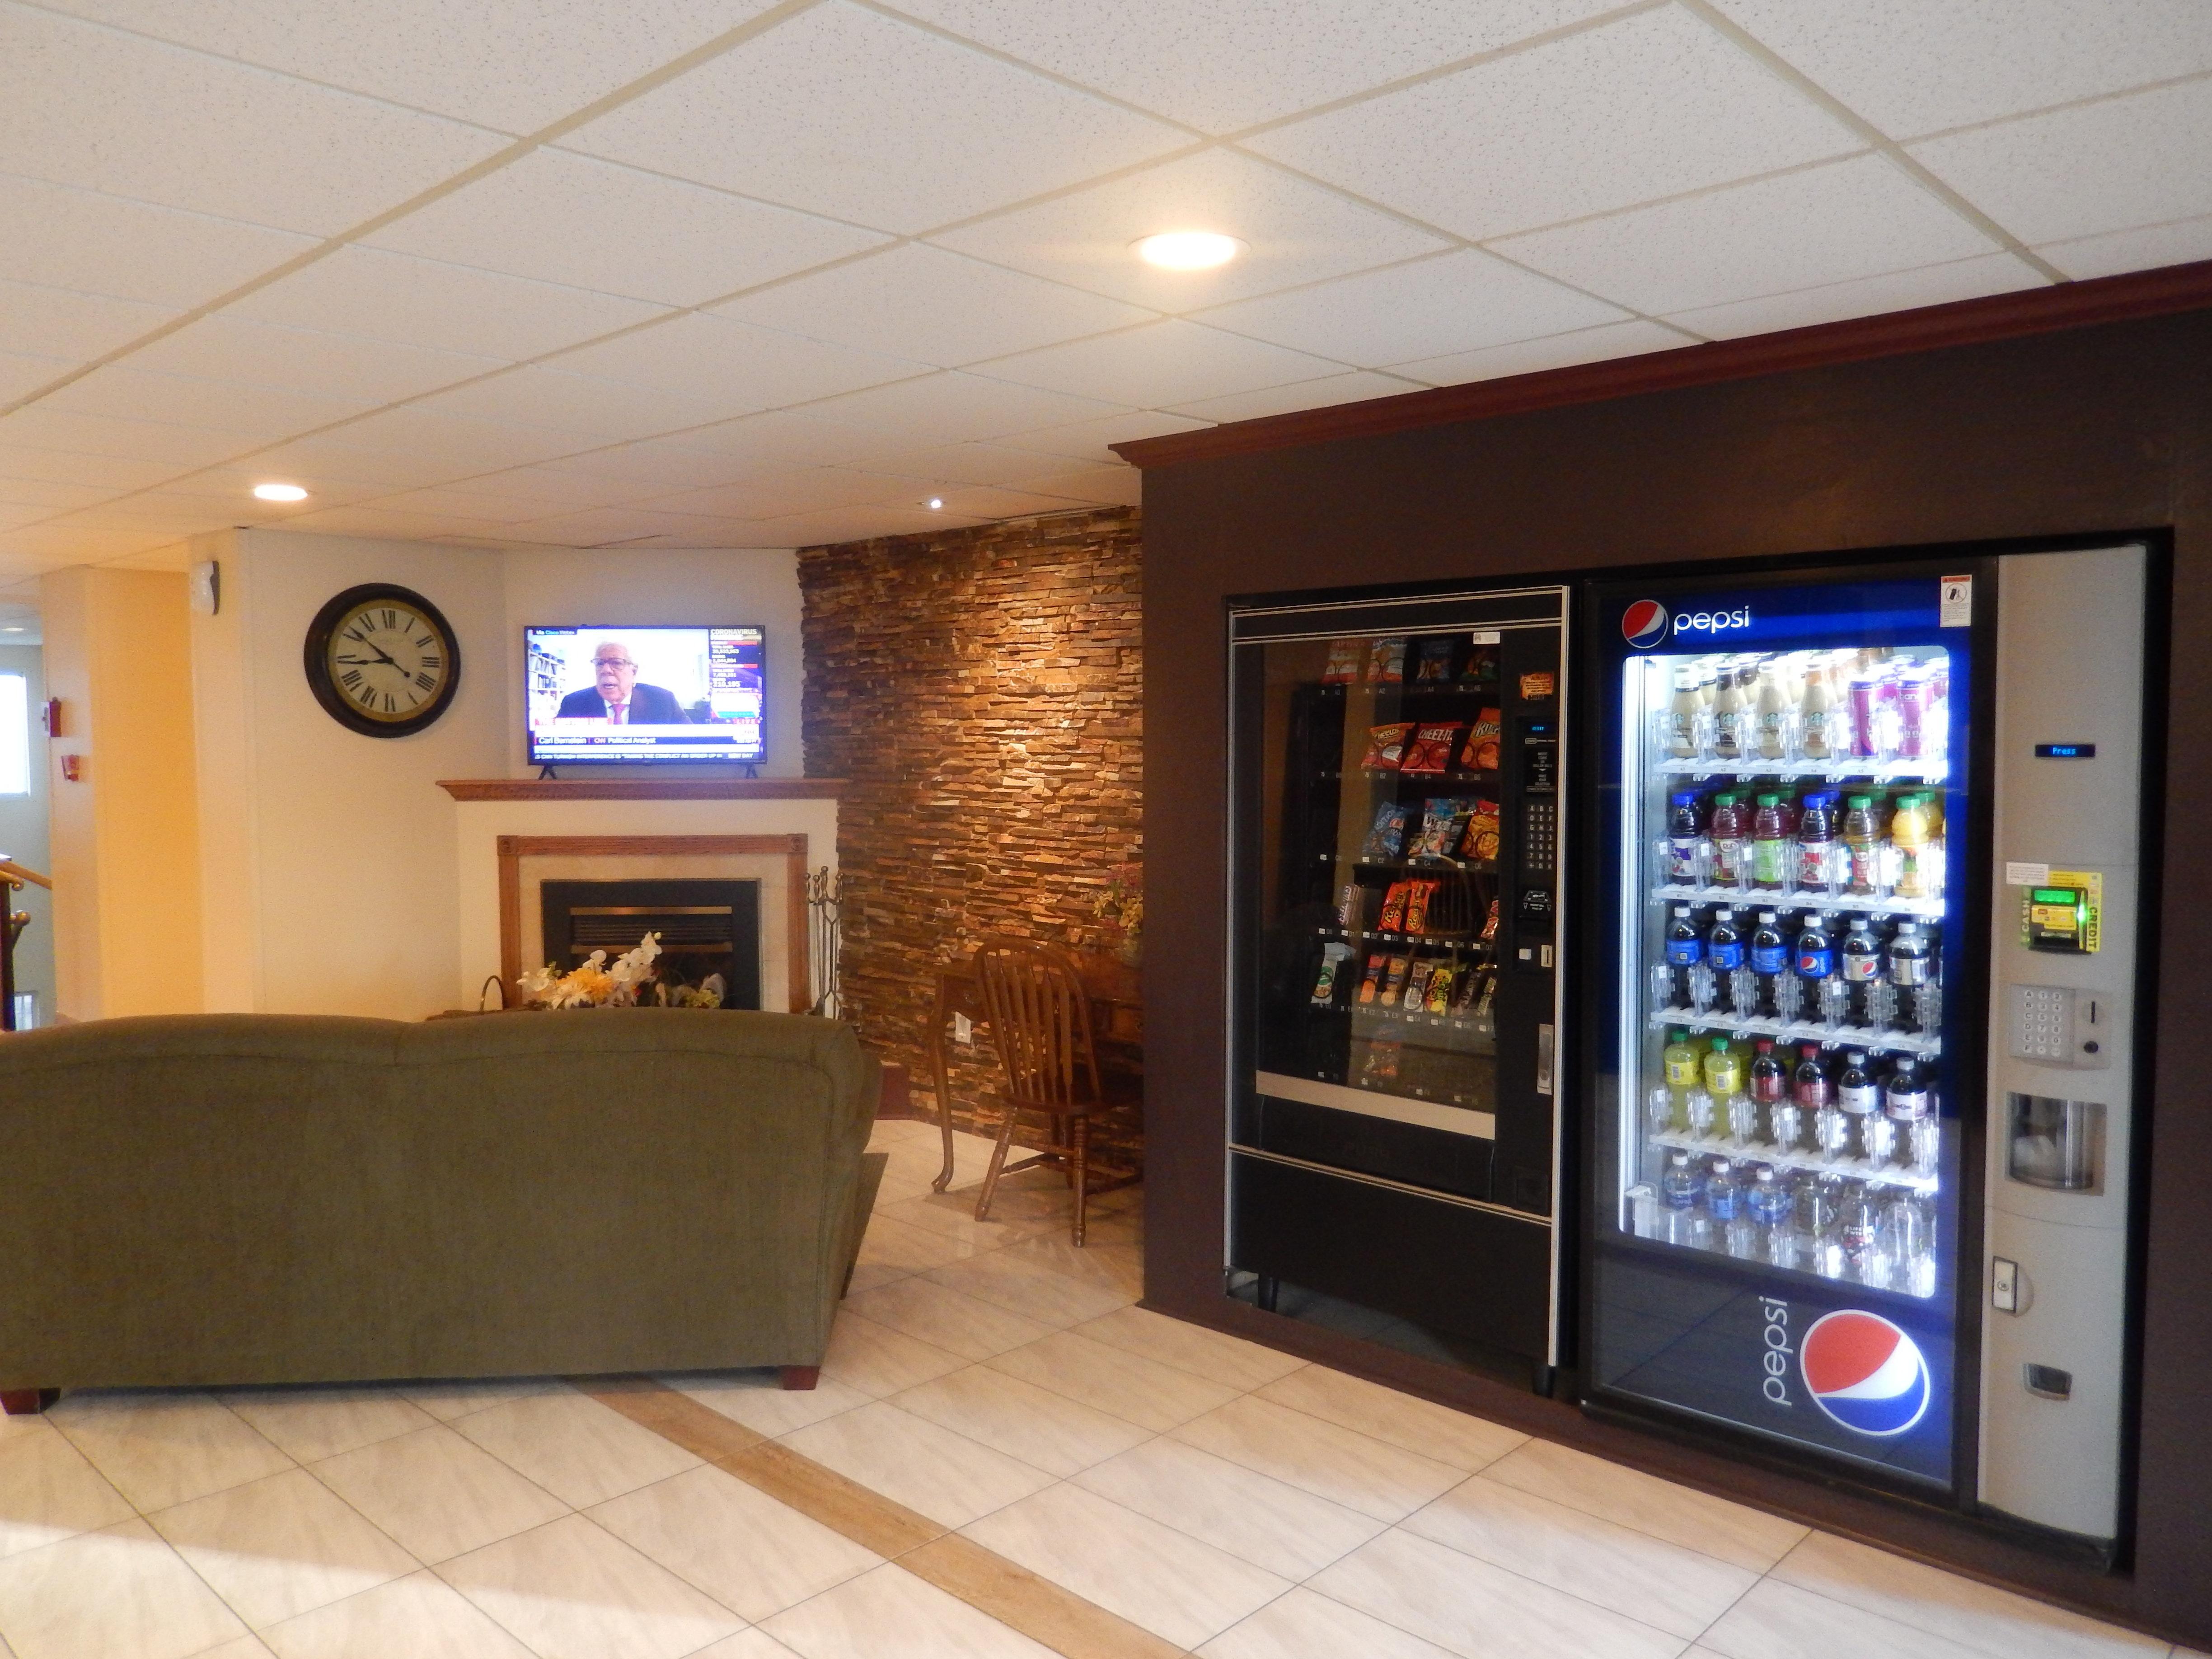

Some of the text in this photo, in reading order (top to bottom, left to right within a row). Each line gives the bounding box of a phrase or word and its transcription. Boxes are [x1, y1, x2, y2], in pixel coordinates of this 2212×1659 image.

[1673, 605, 1749, 635] pepsi
[2087, 907, 2098, 949] CREDIT
[1758, 1295, 1794, 1408] pepsi
